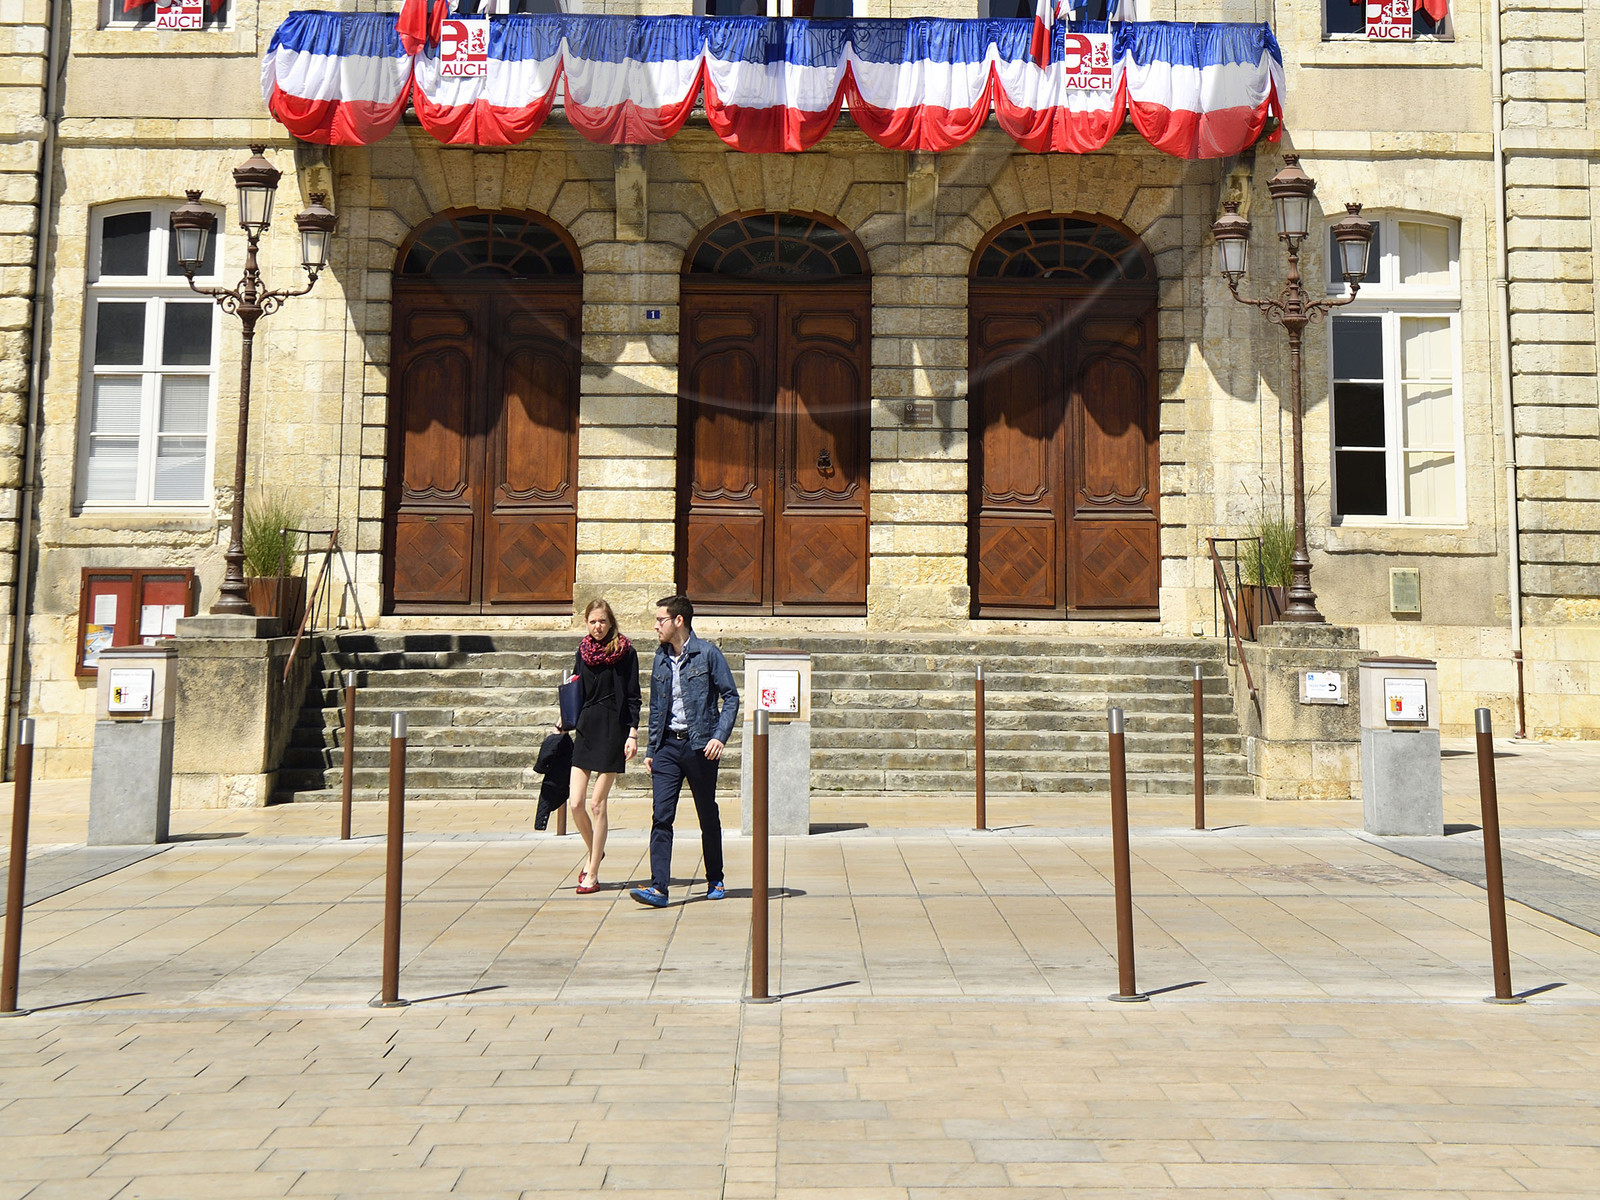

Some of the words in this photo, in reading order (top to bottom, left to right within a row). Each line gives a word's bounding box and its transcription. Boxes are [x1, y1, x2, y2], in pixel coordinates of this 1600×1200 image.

[157, 16, 202, 28] AUCH
[1367, 26, 1412, 39] AUCH
[442, 63, 487, 76] AUCH
[1066, 76, 1112, 89] AUCH
